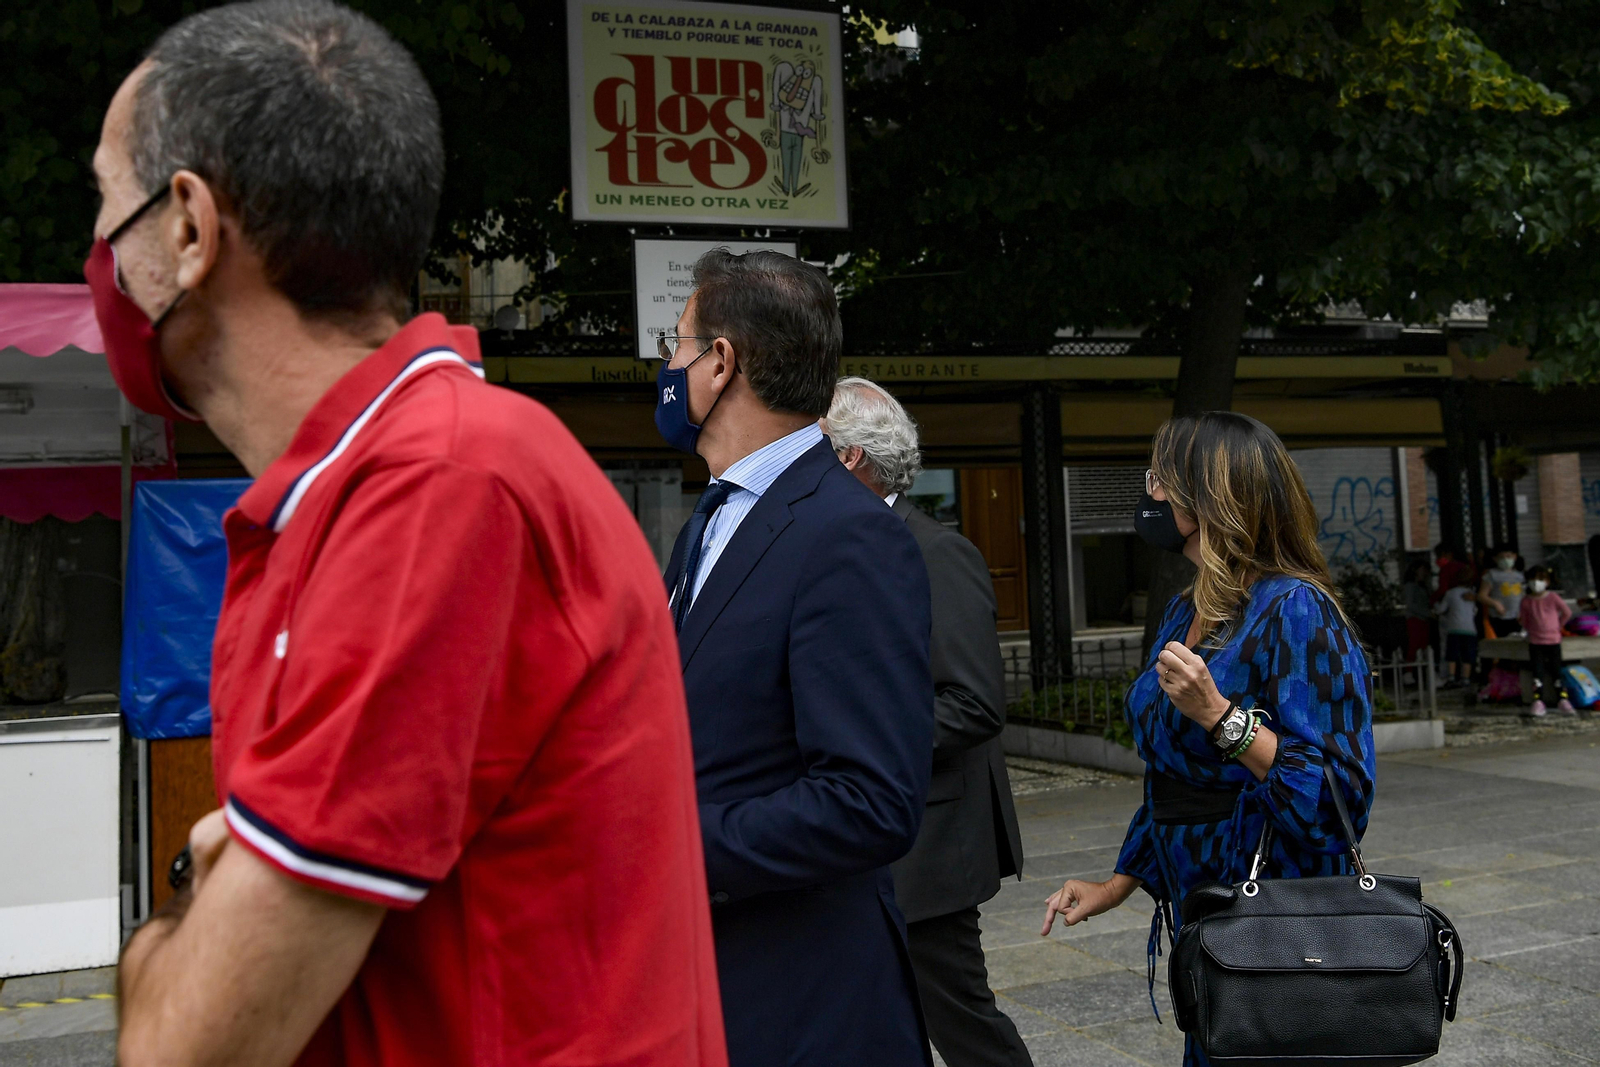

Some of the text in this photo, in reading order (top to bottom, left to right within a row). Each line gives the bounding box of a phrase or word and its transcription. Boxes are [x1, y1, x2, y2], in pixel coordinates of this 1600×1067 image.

[591, 12, 819, 37] DE LA CALABAZA A LA GRANADA
[607, 27, 804, 50] Y TIEMBLO PORQUE ME TOCA
[595, 193, 789, 210] UN MENEO OTRA VEZ
[668, 261, 681, 271] En
[846, 364, 979, 376] ESTAURANTE
